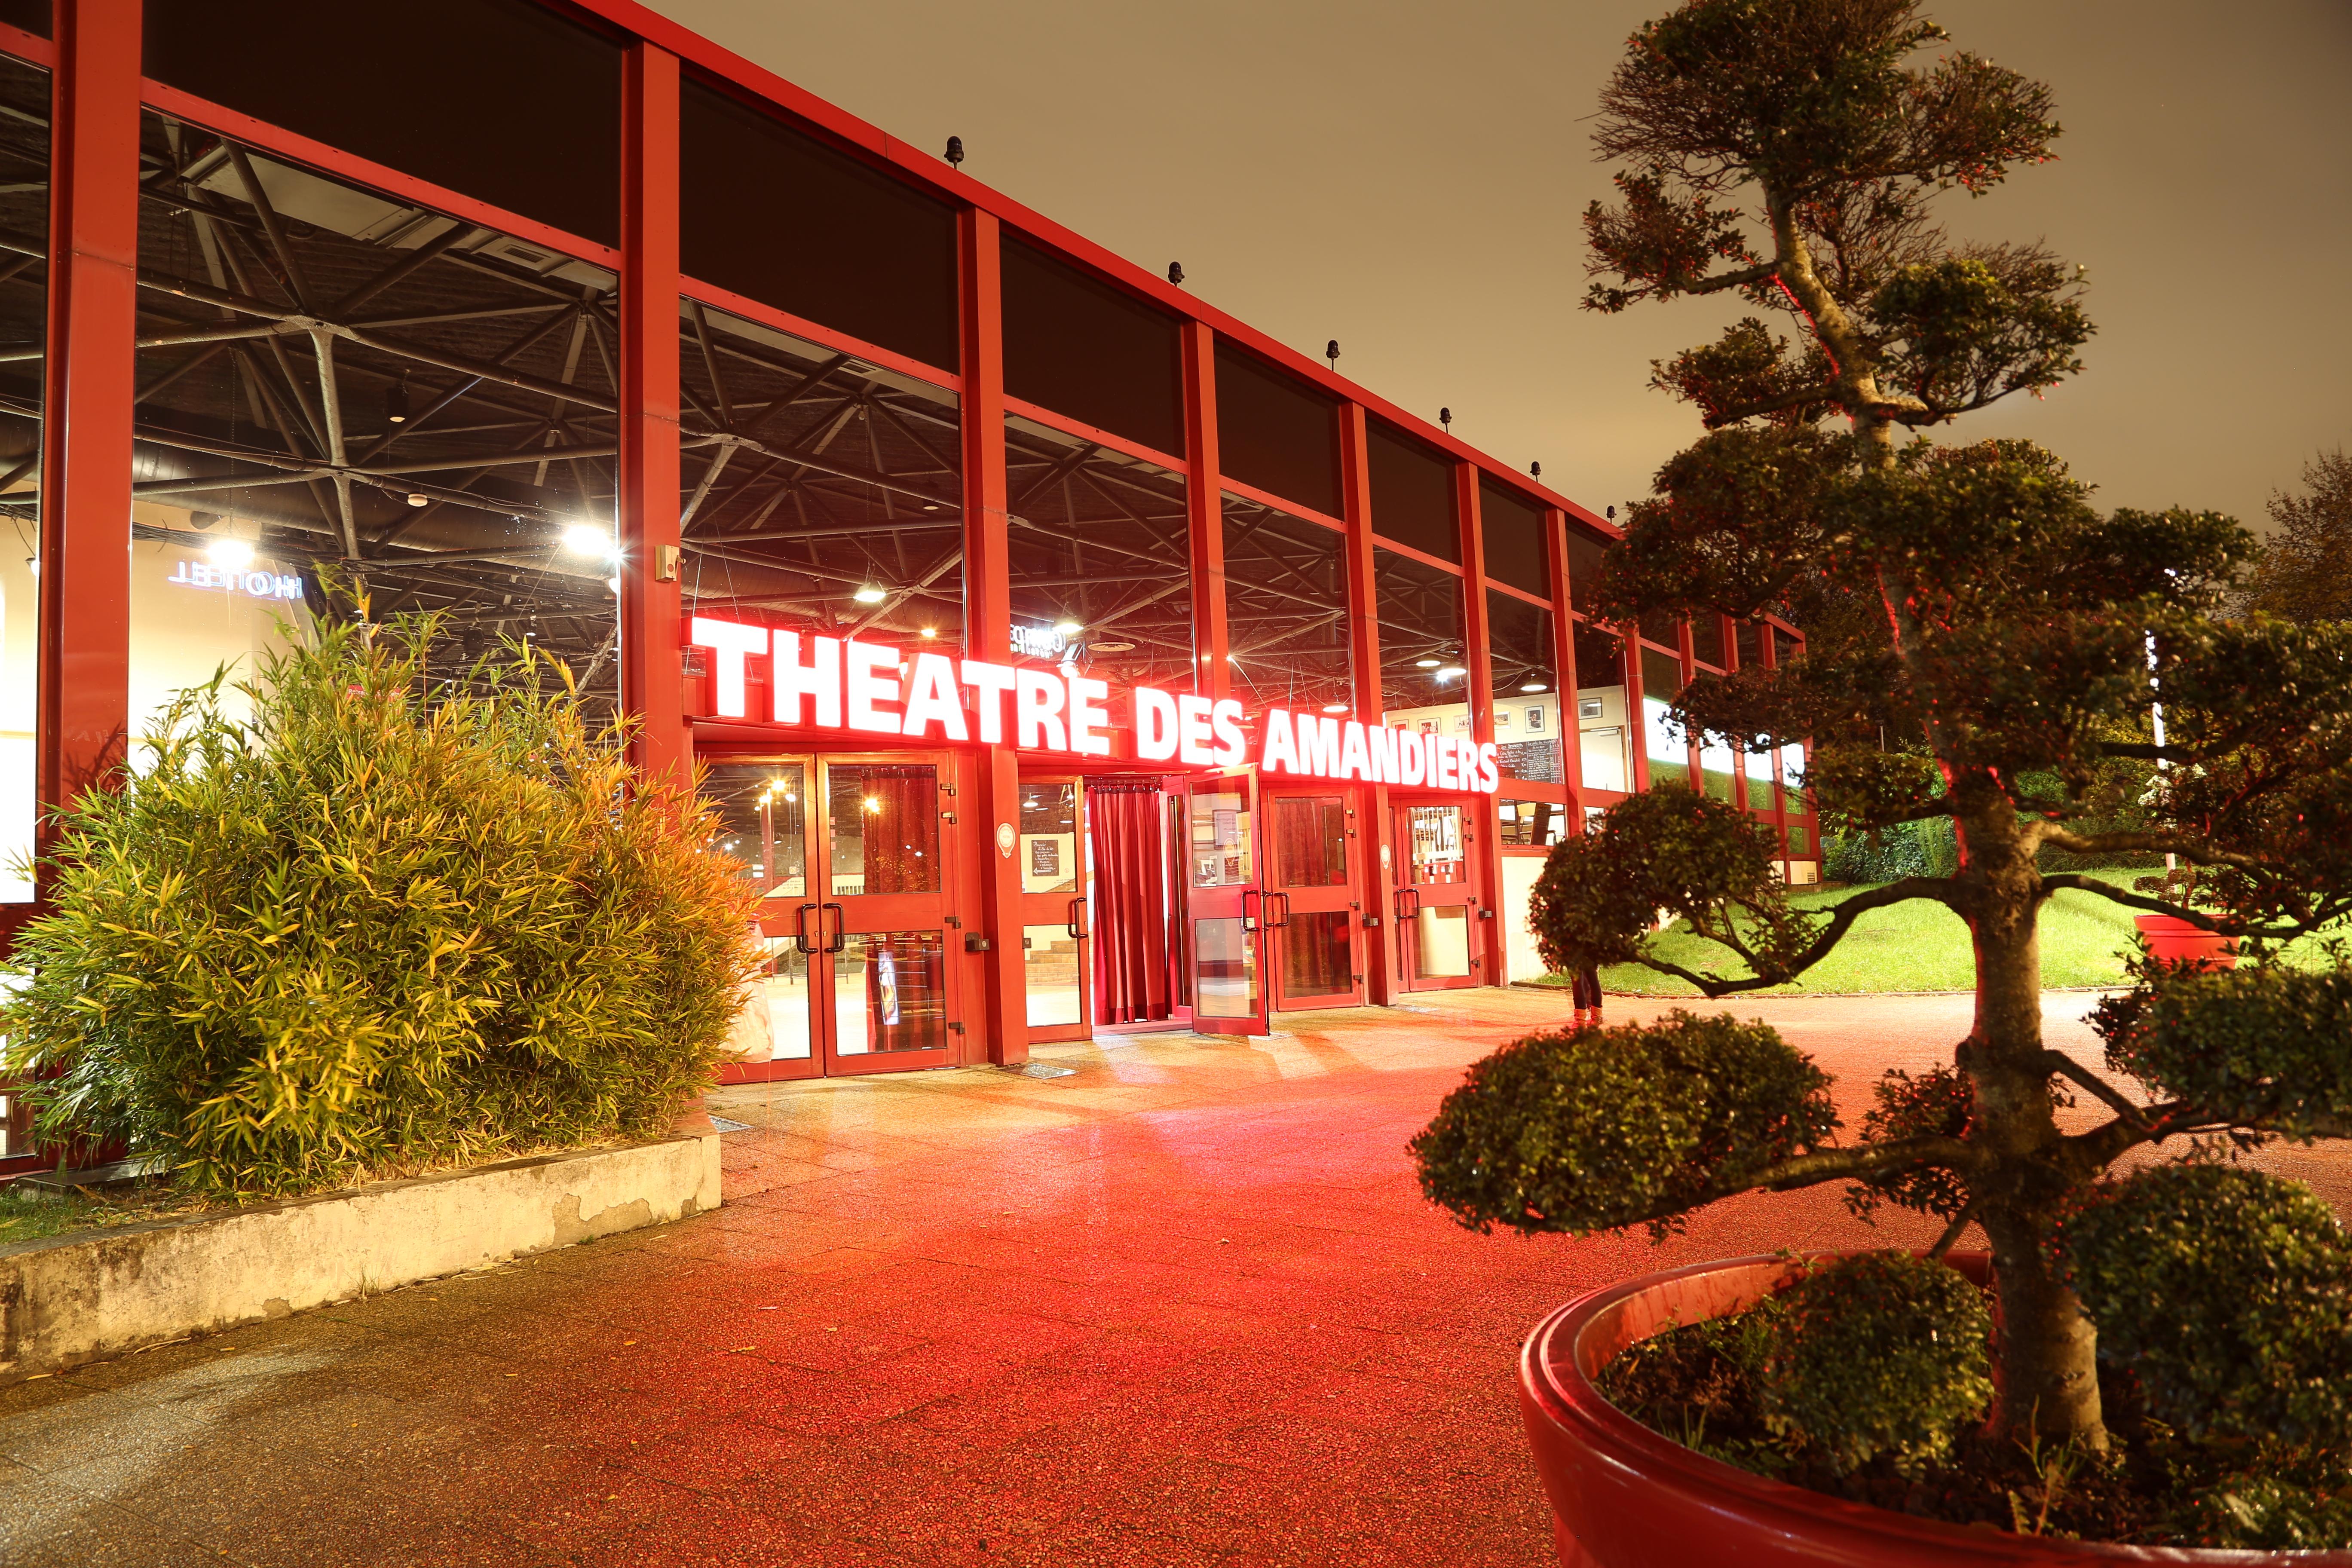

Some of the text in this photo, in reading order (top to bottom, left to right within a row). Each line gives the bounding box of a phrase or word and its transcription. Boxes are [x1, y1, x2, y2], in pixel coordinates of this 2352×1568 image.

[691, 616, 1110, 756] THEATRE
[1135, 686, 1246, 767] DES
[1262, 709, 1499, 794] AMANDIERS
